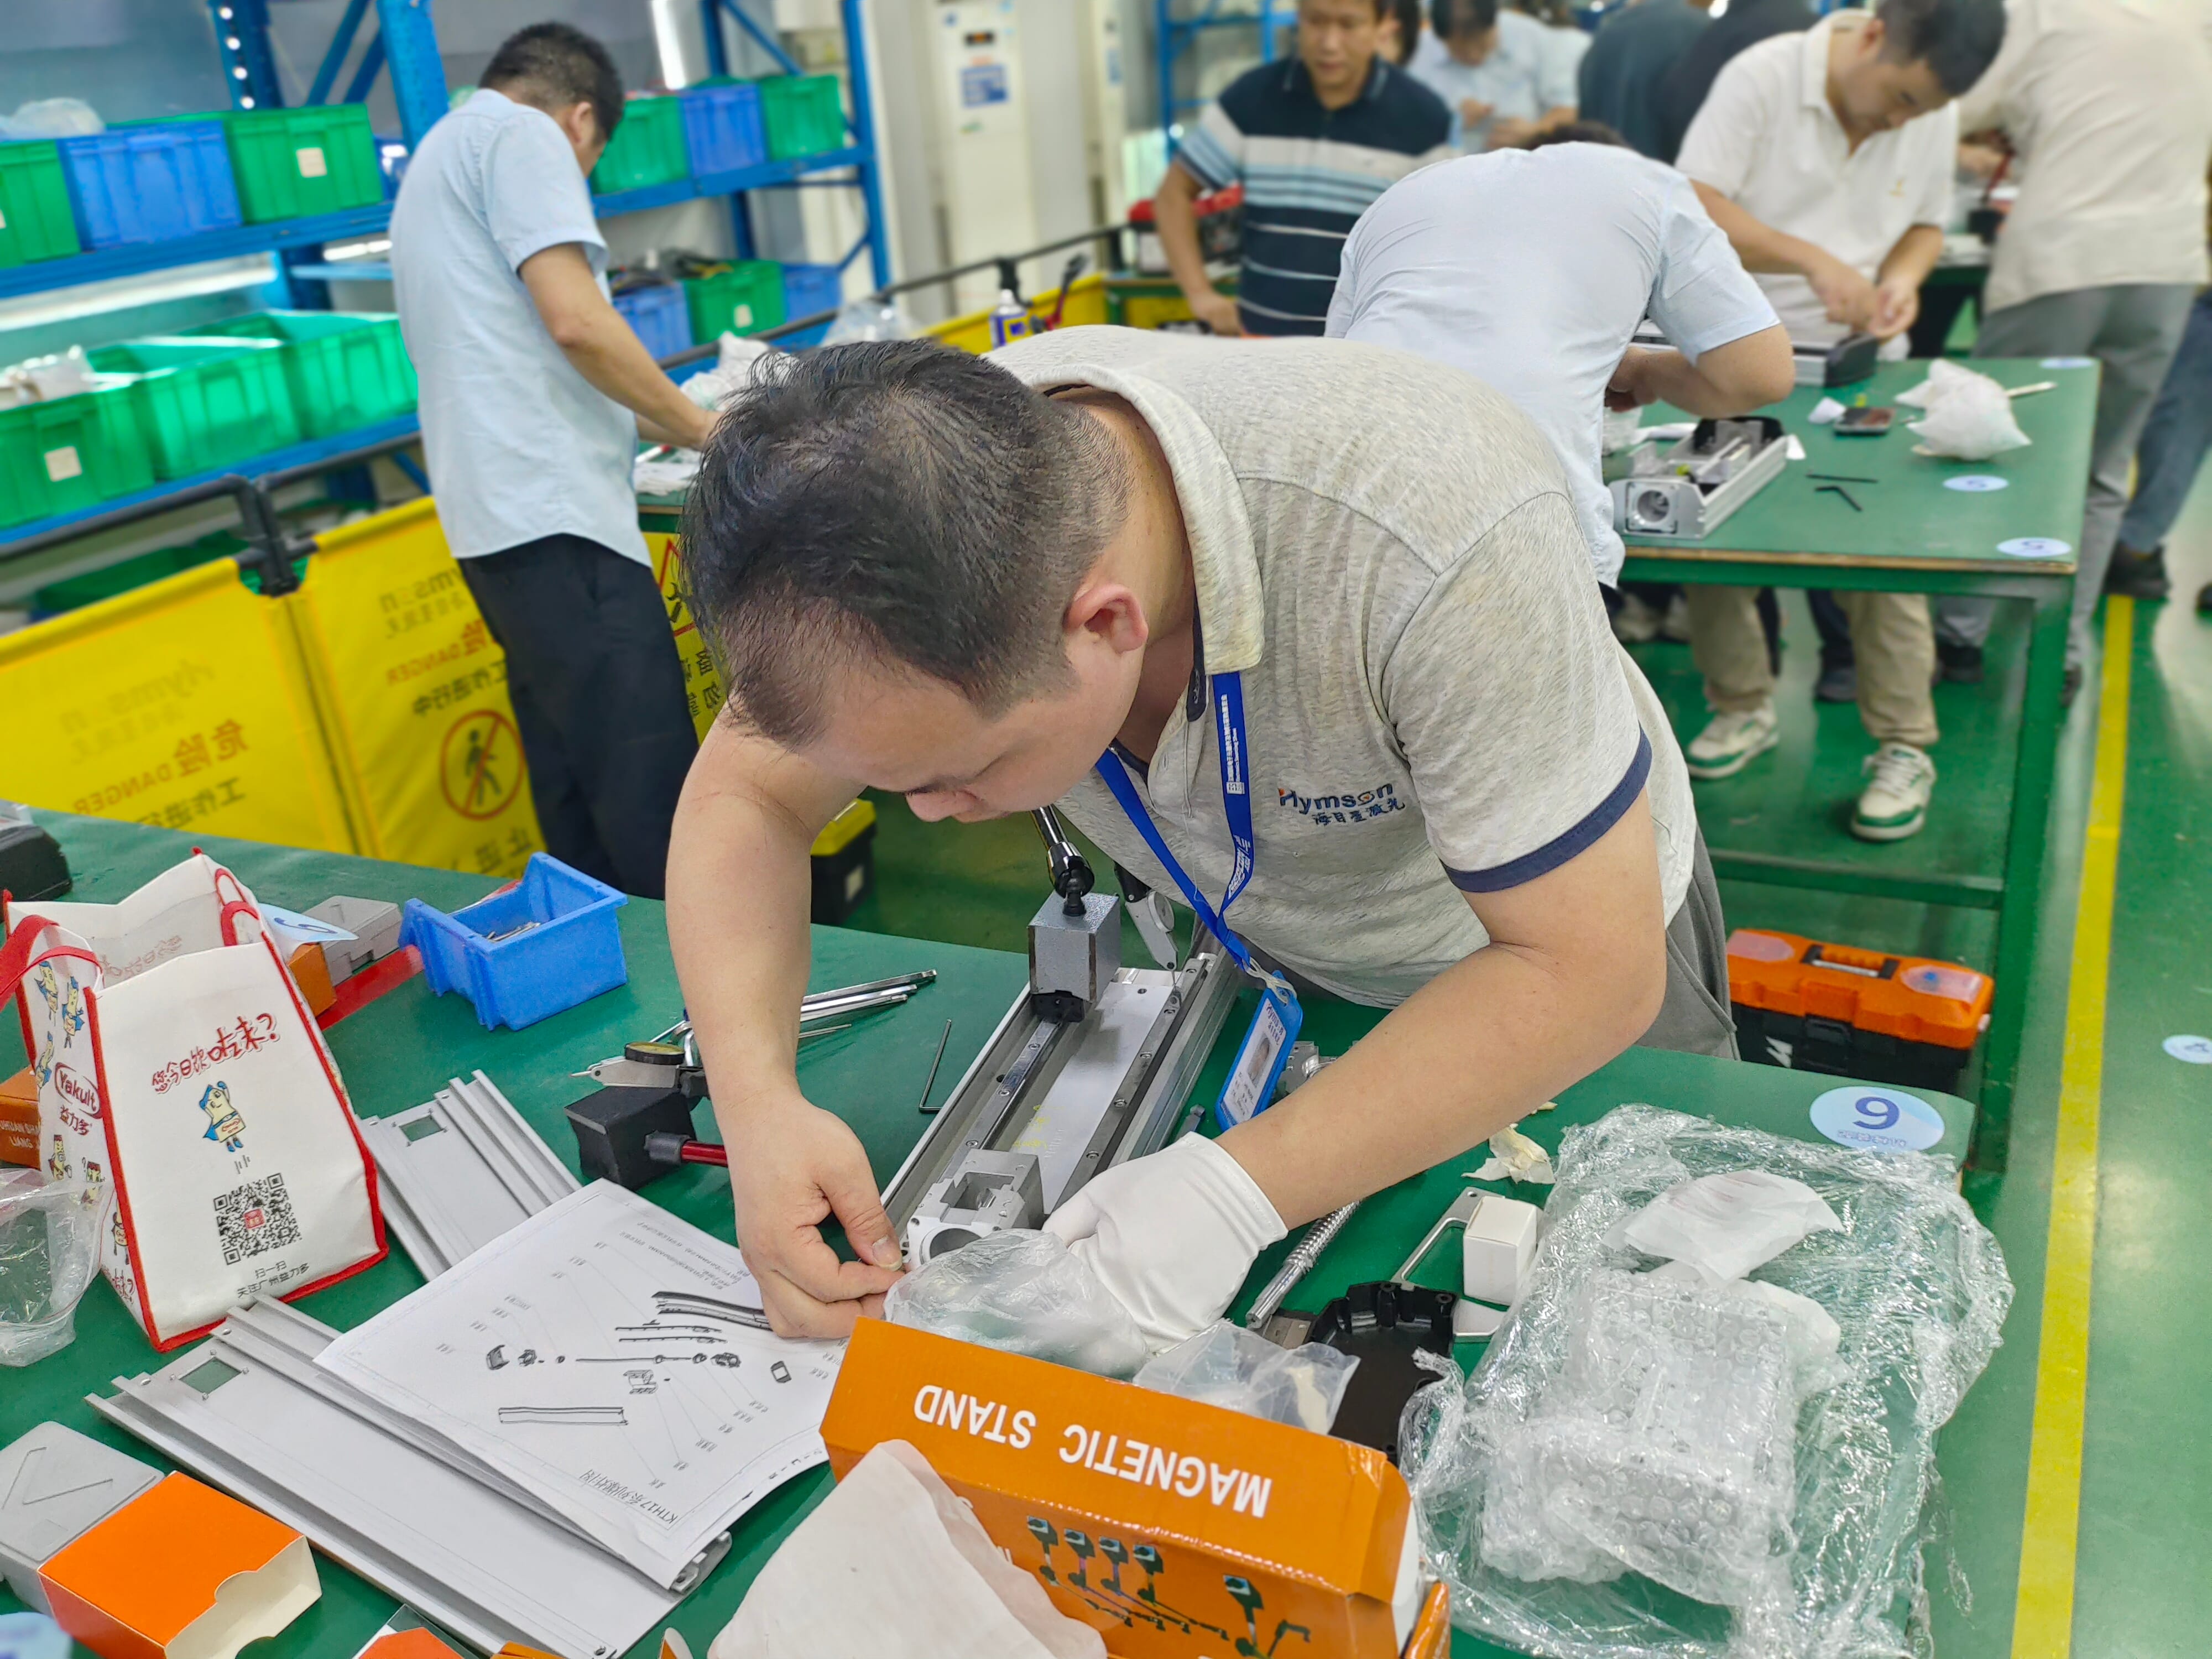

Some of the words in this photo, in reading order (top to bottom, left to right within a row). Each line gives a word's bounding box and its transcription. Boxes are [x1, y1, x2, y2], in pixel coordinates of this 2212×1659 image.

[1278, 783, 1393, 815] Hymson
[60, 1070, 96, 1112] Yakult
[59, 1105, 90, 1135] 益力多
[1853, 1097, 1900, 1129] 9
[255, 1260, 287, 1279] 扫一扫
[914, 1384, 1036, 1450] STAND
[1058, 1424, 1272, 1518] MAGNETIC
